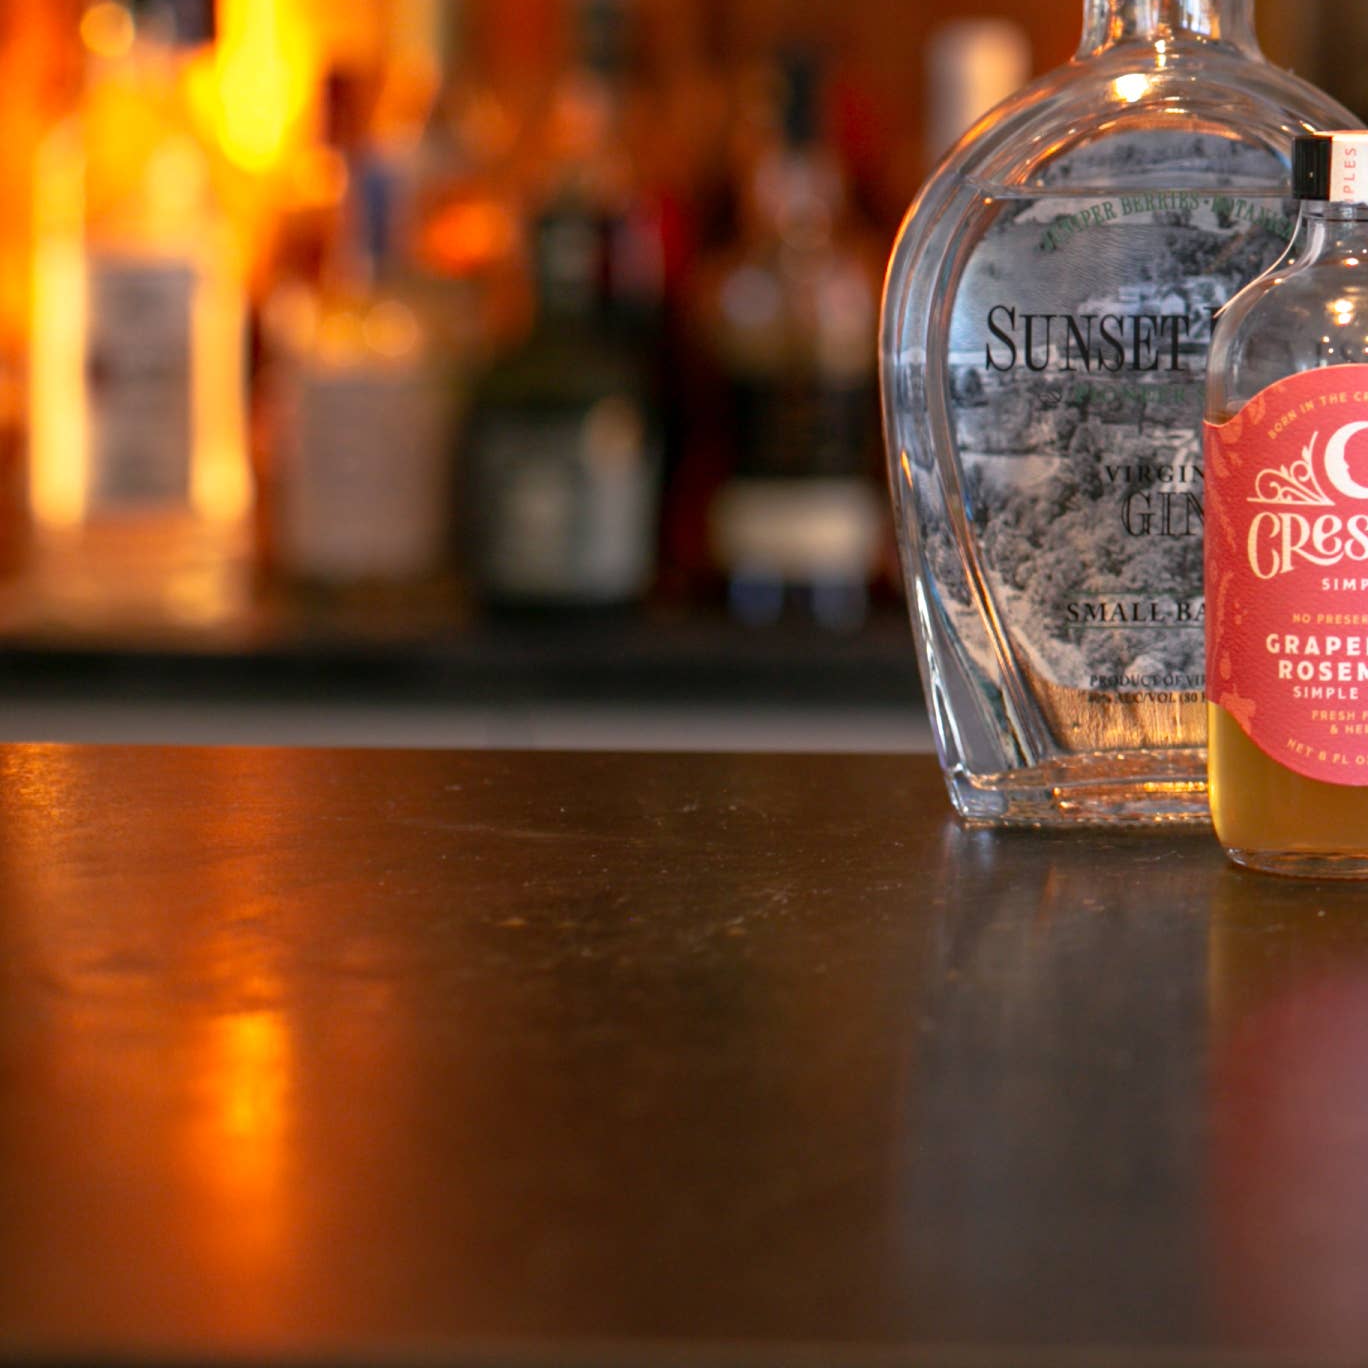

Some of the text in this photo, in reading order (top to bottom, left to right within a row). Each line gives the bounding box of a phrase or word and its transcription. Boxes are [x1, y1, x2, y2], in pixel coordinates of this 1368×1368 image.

[986, 305, 1190, 372] SUNSET
[1268, 410, 1297, 439] BORN
[1300, 400, 1315, 414] IN
[1320, 391, 1348, 407] THE
[1121, 490, 1204, 536] GIN
[1292, 613, 1312, 624] NO
[1293, 685, 1359, 699] SIMPLE
[1311, 710, 1356, 721] FRESH
[1329, 724, 1339, 735] &
[1287, 738, 1313, 757] NET
[1332, 753, 1349, 764] FL
